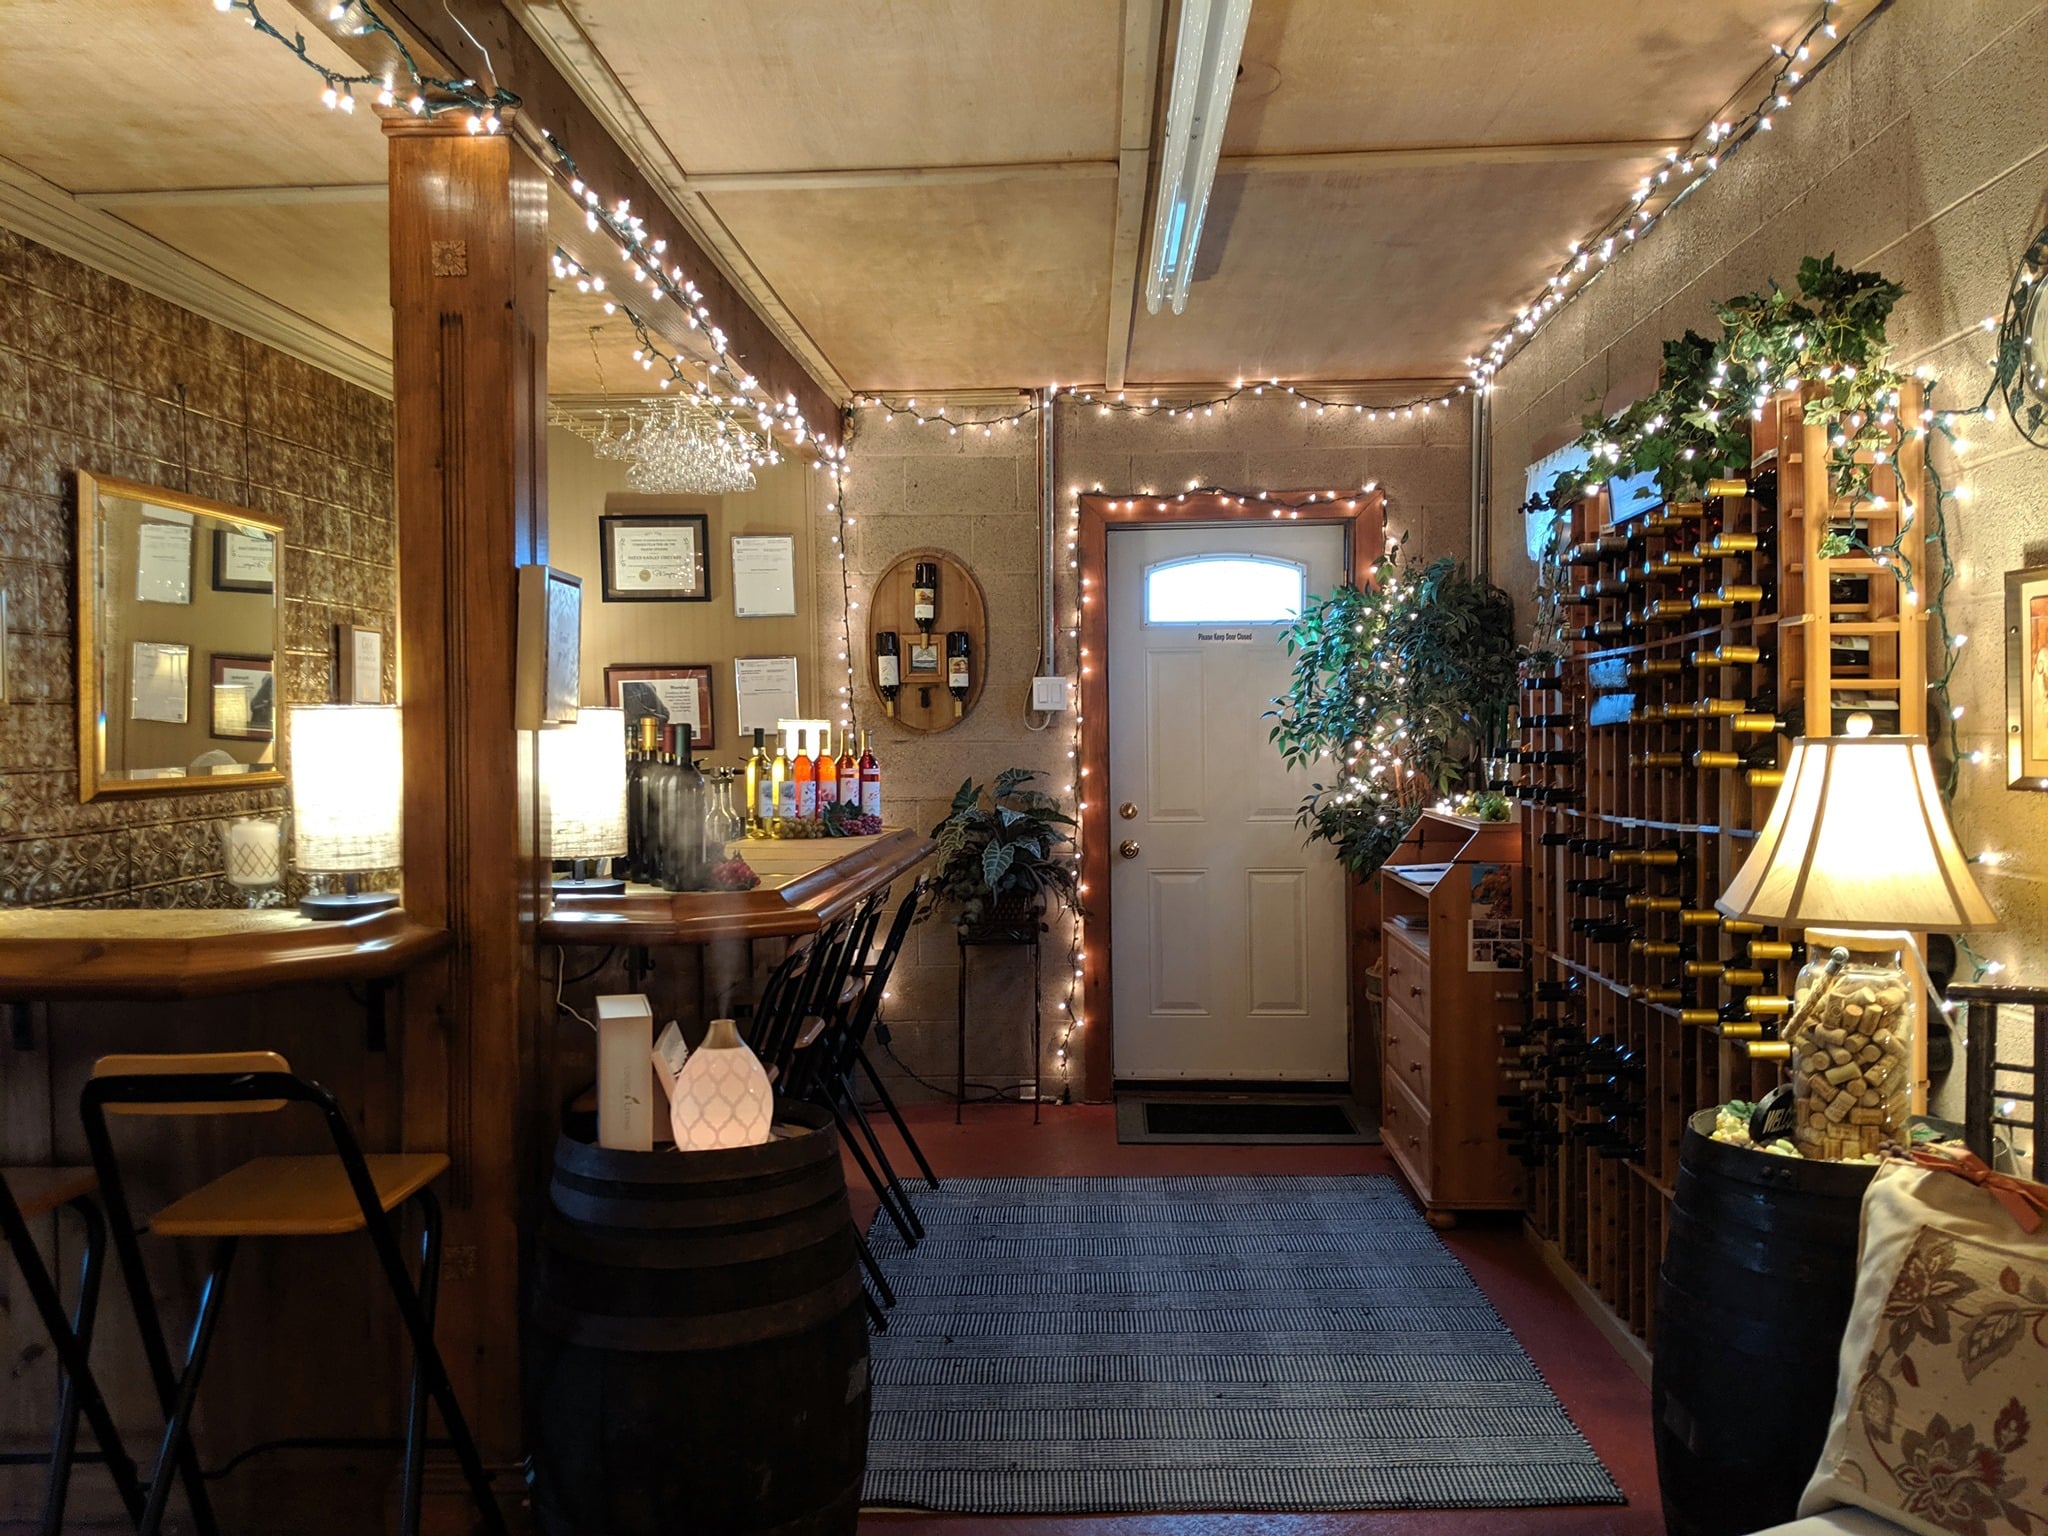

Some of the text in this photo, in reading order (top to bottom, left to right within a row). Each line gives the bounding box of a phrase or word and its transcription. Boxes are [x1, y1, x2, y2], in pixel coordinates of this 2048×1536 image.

[1198, 633, 1252, 642] Please Keep Door Closed
